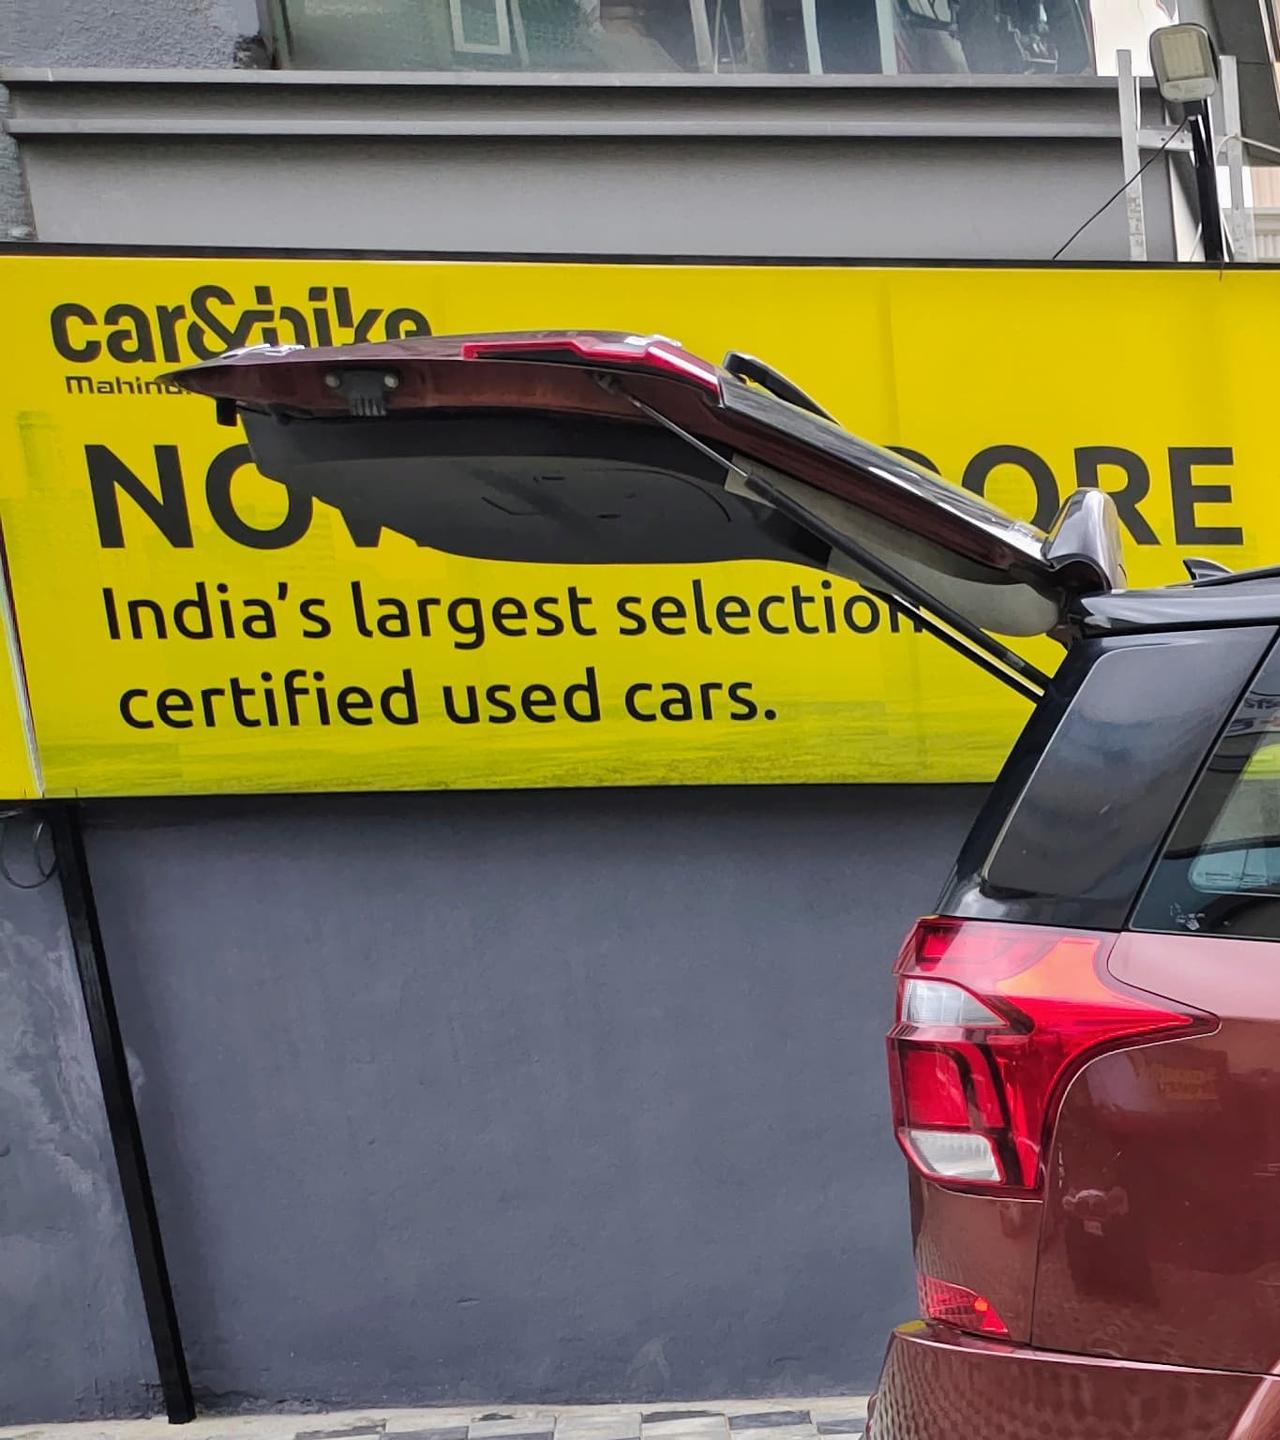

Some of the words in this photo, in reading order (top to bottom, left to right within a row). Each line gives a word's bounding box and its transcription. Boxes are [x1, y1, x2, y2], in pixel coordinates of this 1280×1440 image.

[51, 285, 431, 363] car&bike
[103, 582, 331, 640] India's
[351, 581, 597, 650] largest
[617, 579, 923, 636] selection
[120, 669, 418, 729] certified
[443, 667, 600, 725] used
[625, 680, 776, 723] cars.
